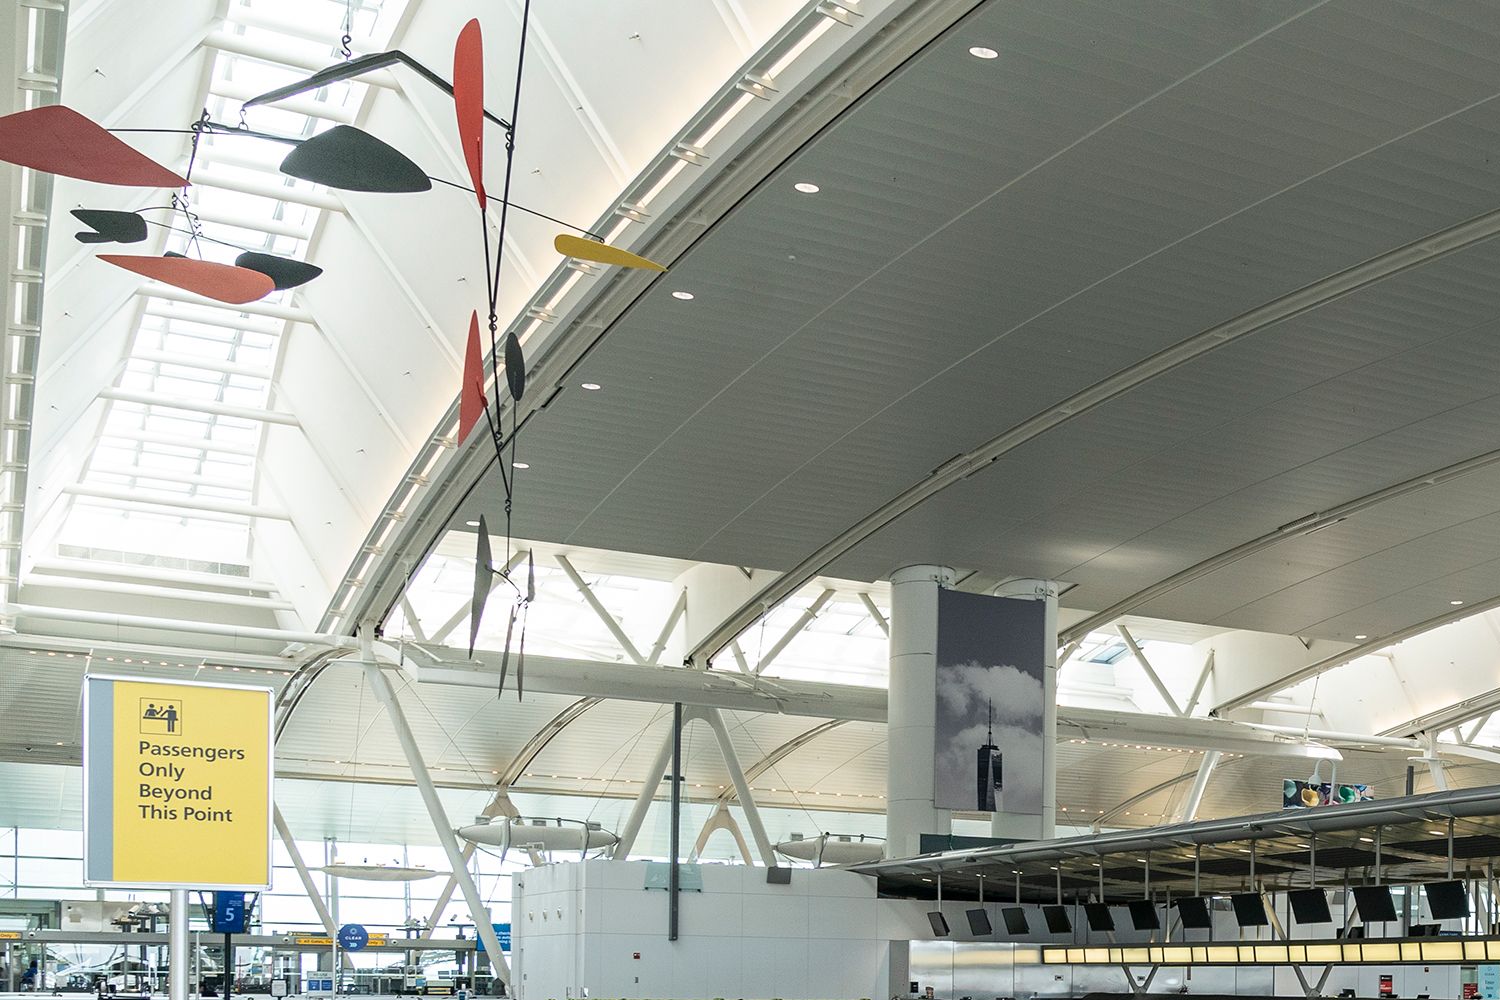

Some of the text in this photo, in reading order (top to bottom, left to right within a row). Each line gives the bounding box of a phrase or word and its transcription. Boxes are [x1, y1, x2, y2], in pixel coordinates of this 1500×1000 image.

[139, 740, 245, 762] Passengers
[139, 762, 185, 782] Only
[139, 783, 212, 803] Beyond
[138, 804, 233, 822] This Point
[225, 907, 235, 921] 5
